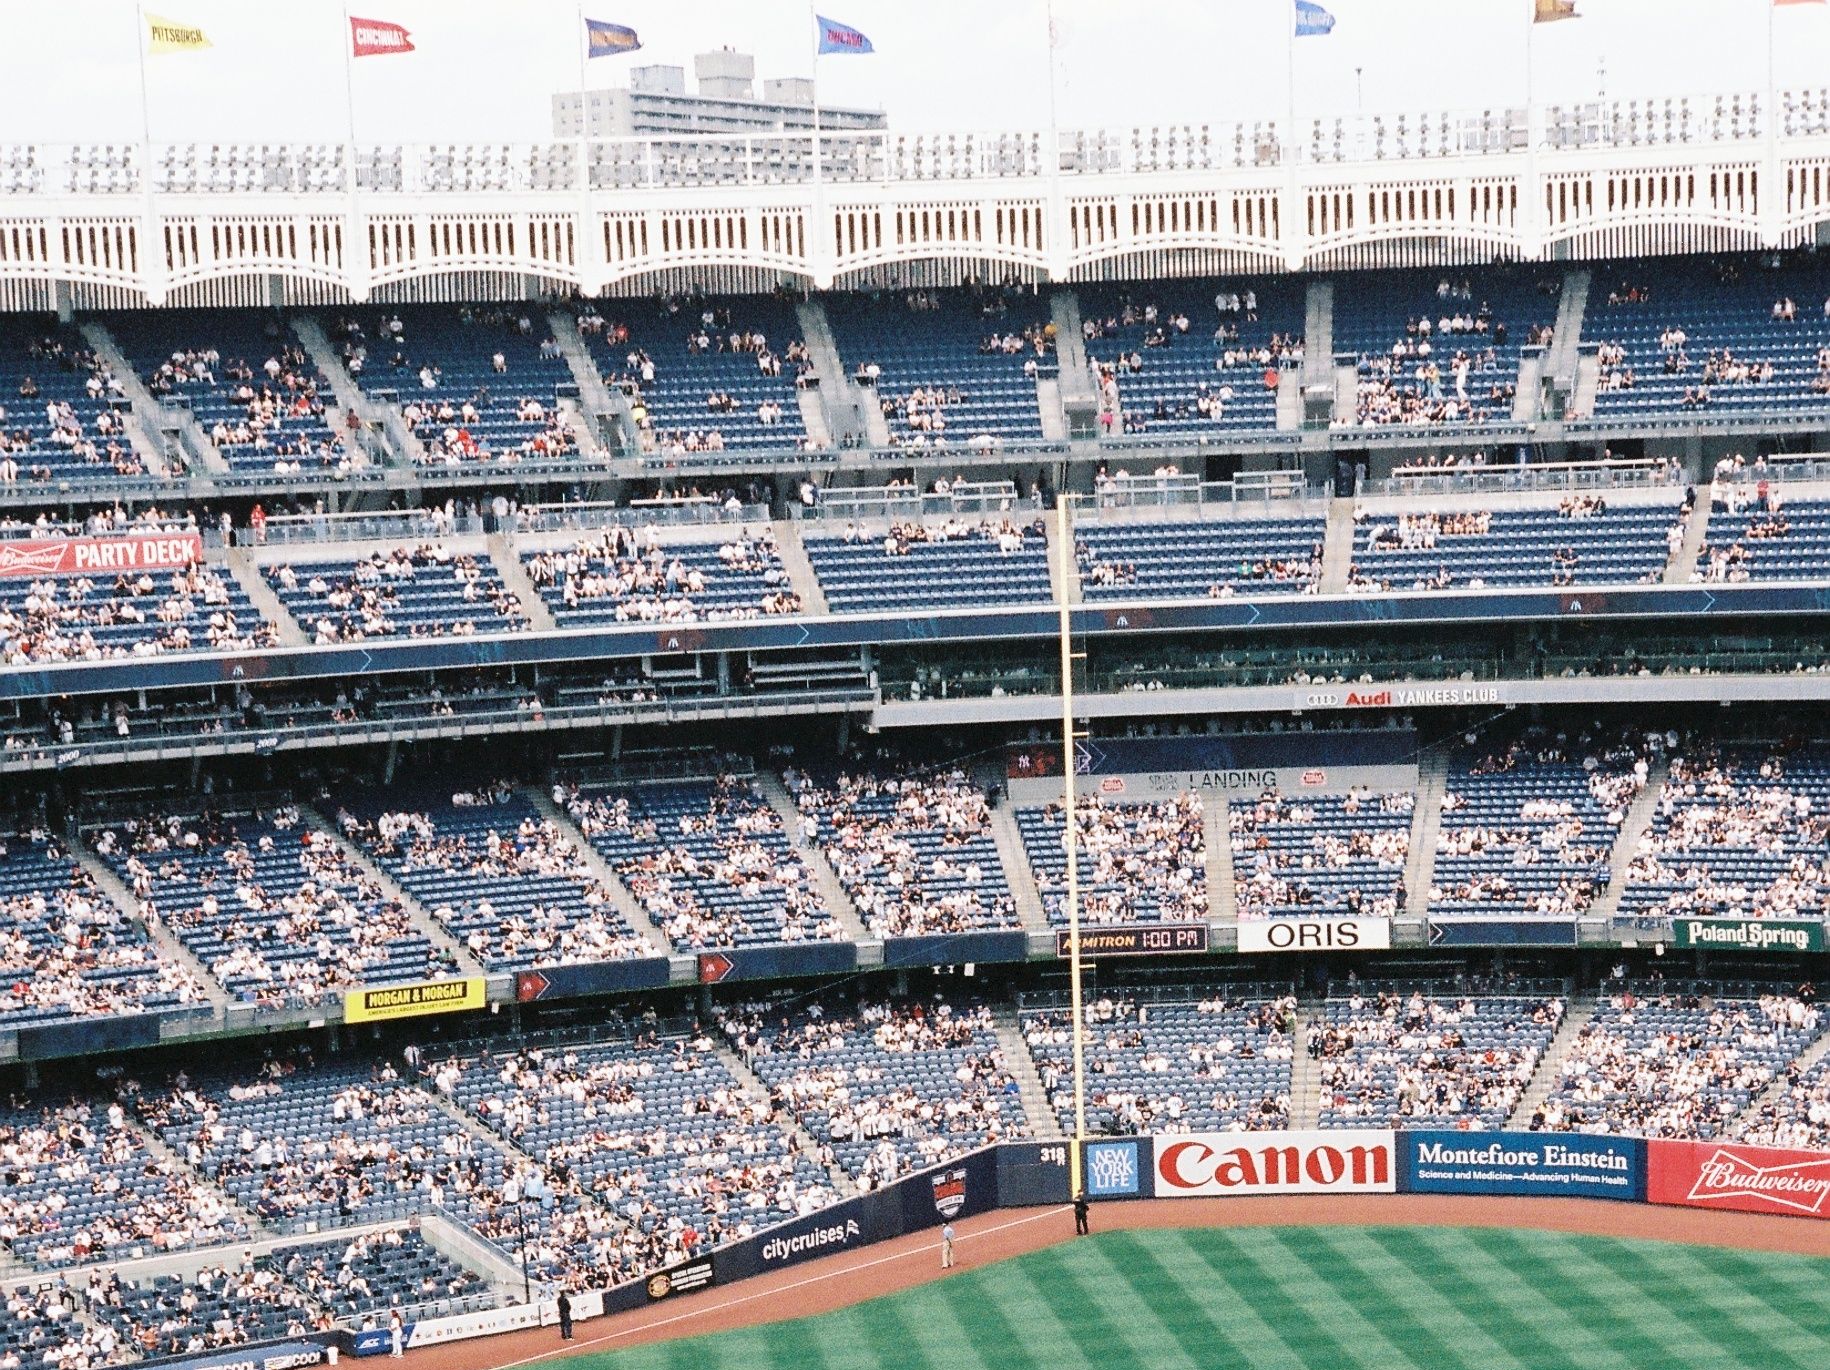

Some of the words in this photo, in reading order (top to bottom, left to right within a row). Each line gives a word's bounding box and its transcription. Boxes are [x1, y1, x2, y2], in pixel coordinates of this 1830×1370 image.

[75, 541, 138, 568] PARTY
[143, 539, 195, 564] DECK
[1346, 691, 1392, 706] Audi
[1398, 689, 1459, 705] YANKEES
[1463, 688, 1498, 703] CLUB
[57, 750, 80, 764] 2000
[1190, 770, 1277, 790] LANDING
[1142, 932, 1171, 948] 1:00
[1177, 930, 1197, 945] PM
[1267, 922, 1359, 948] ORIS
[1688, 921, 1746, 945] Poland
[1748, 922, 1808, 949] Spring
[369, 989, 410, 1007] MORGAN
[412, 988, 420, 1002] &
[422, 983, 463, 1000] MORGAN
[1040, 1147, 1065, 1161] 318
[1096, 1149, 1130, 1163] NEW
[1418, 1143, 1538, 1165] Montefiore
[1543, 1145, 1628, 1171] Einstein
[1091, 1161, 1134, 1176] YORK
[1159, 1141, 1388, 1188] Canon
[1096, 1174, 1129, 1188] LIFE
[1418, 1169, 1453, 1179] Science
[1454, 1170, 1471, 1180] and
[1571, 1174, 1600, 1183] Human
[1601, 1175, 1628, 1186] Health
[1701, 1160, 1830, 1193] Budweiser
[763, 1225, 844, 1259] citycruises
